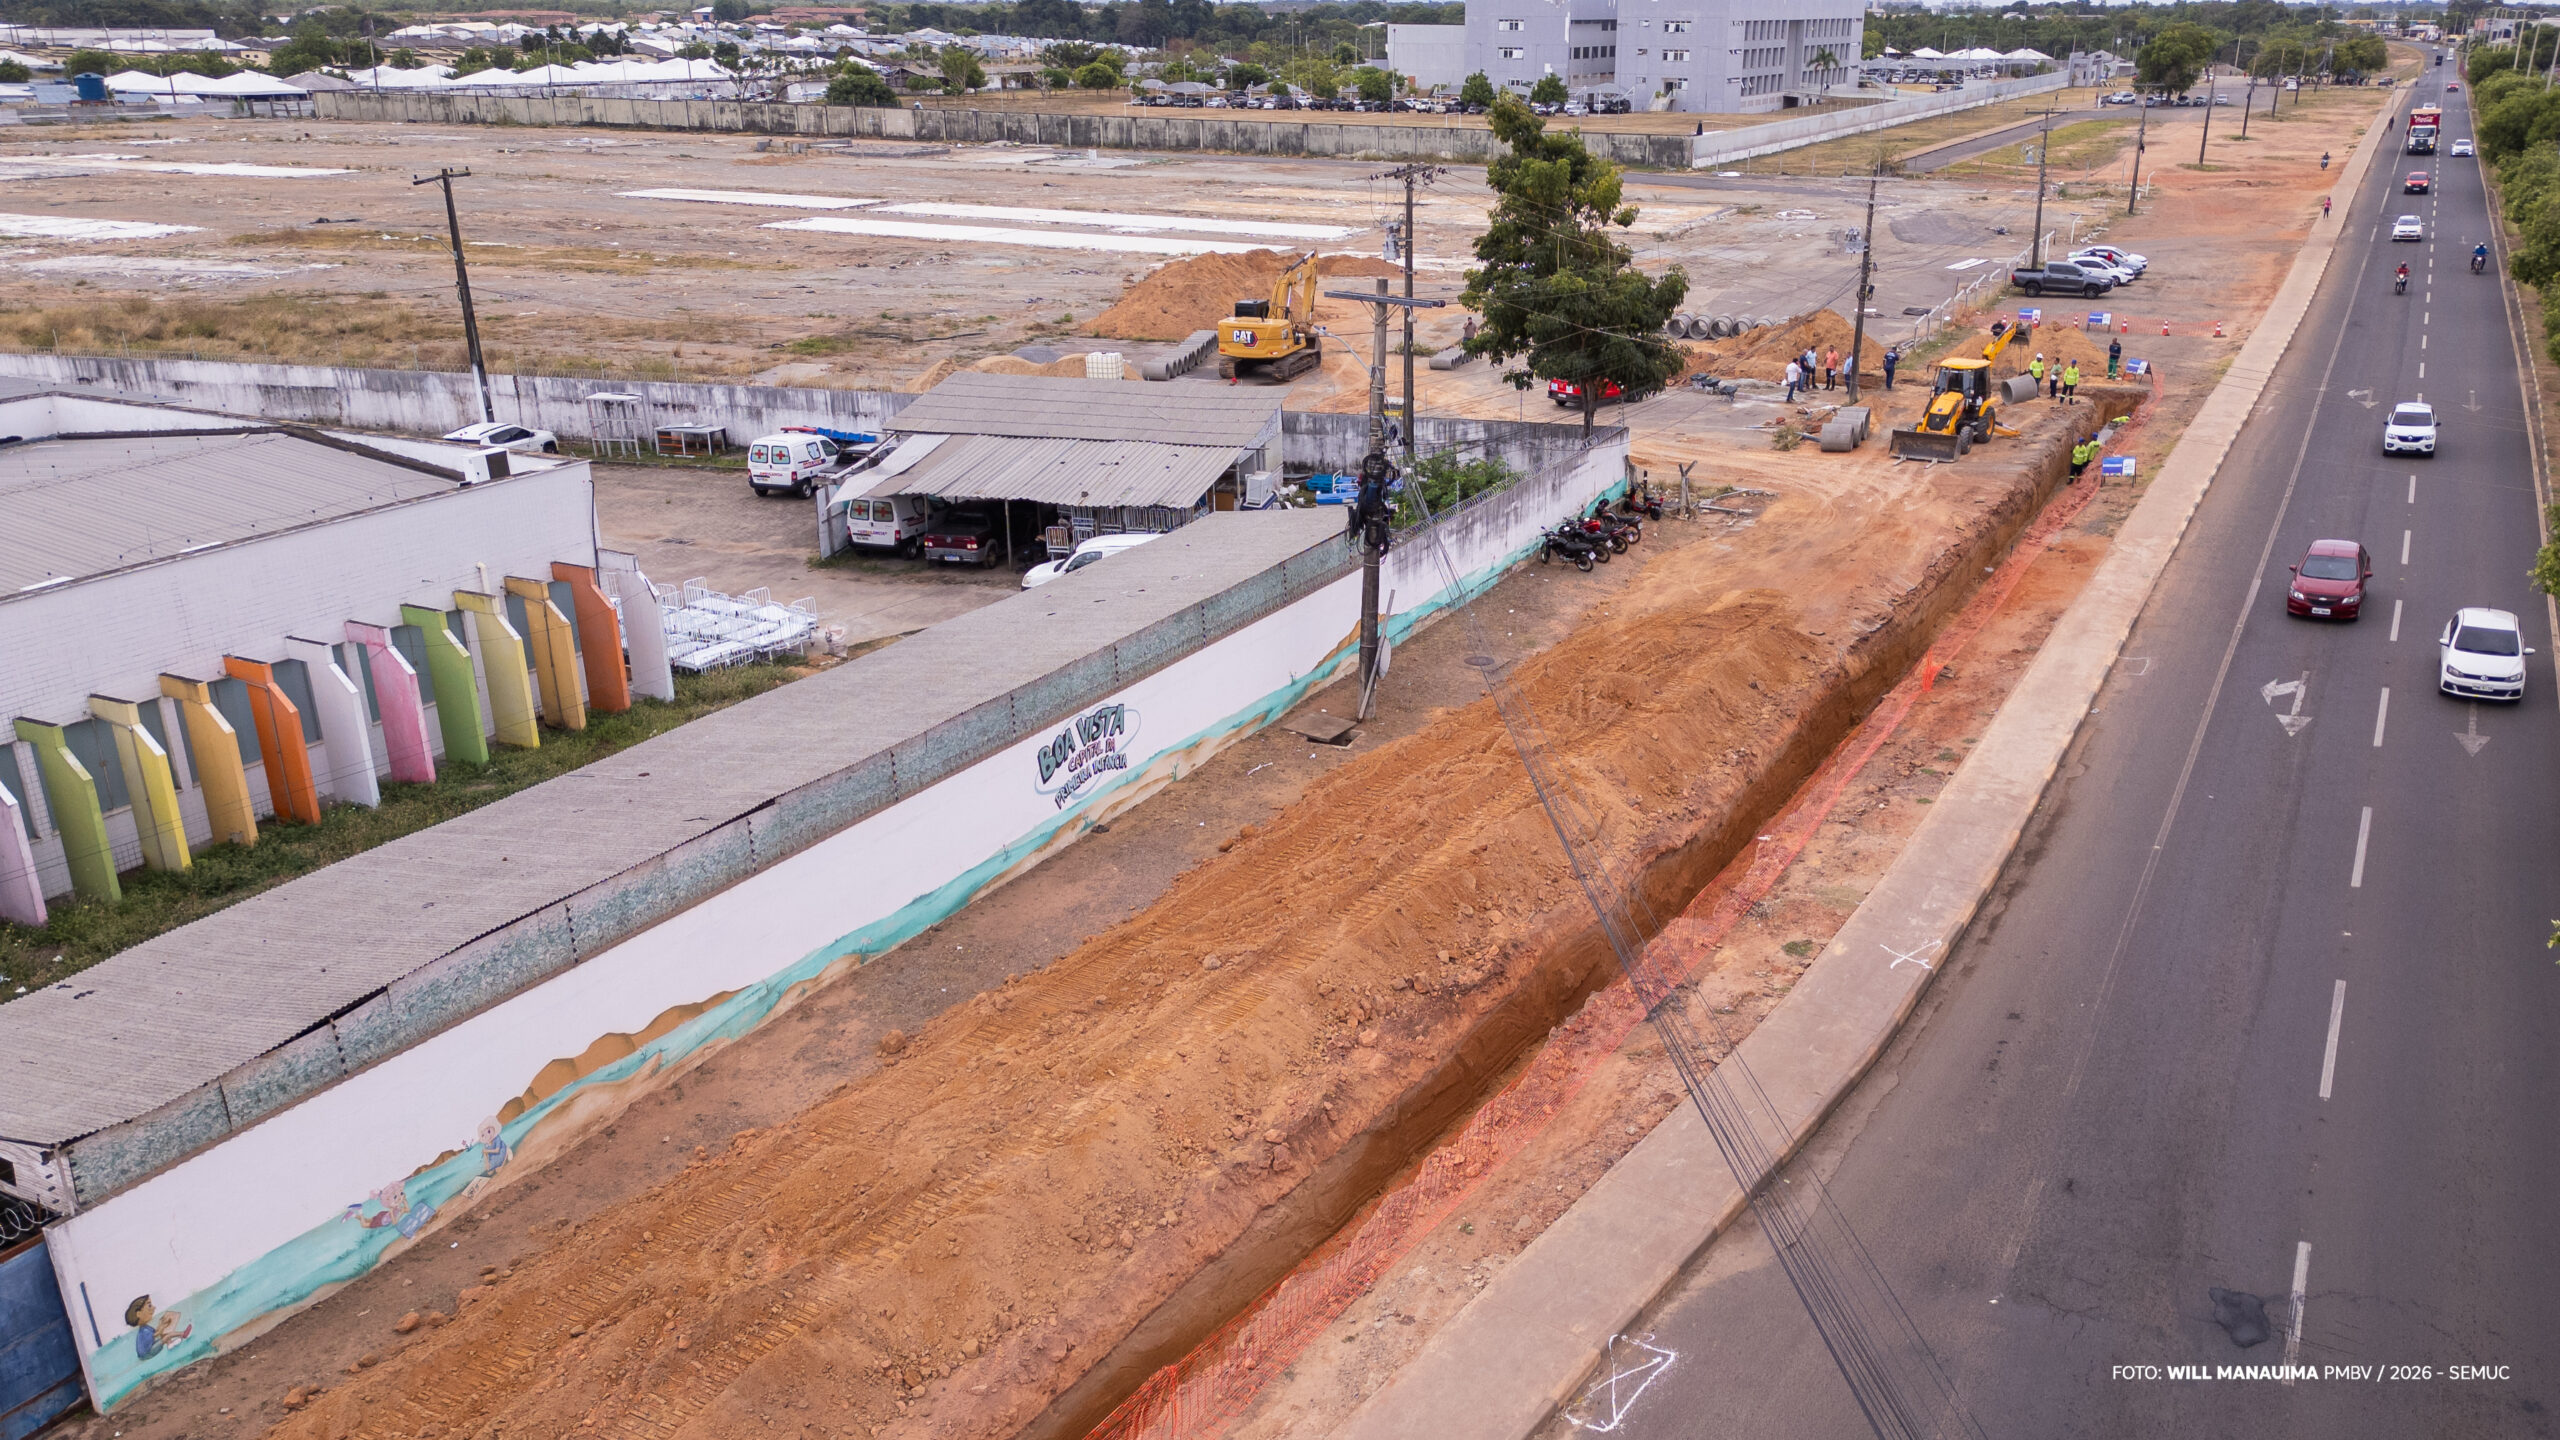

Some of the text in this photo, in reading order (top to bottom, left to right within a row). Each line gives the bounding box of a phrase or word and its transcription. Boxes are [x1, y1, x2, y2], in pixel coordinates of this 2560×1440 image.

[1233, 329, 1252, 344] CAT
[1037, 703, 1125, 785] BOA VISTA
[1068, 737, 1116, 773] CAPITAL DA
[1054, 764, 1092, 810] PRIMEIRA
